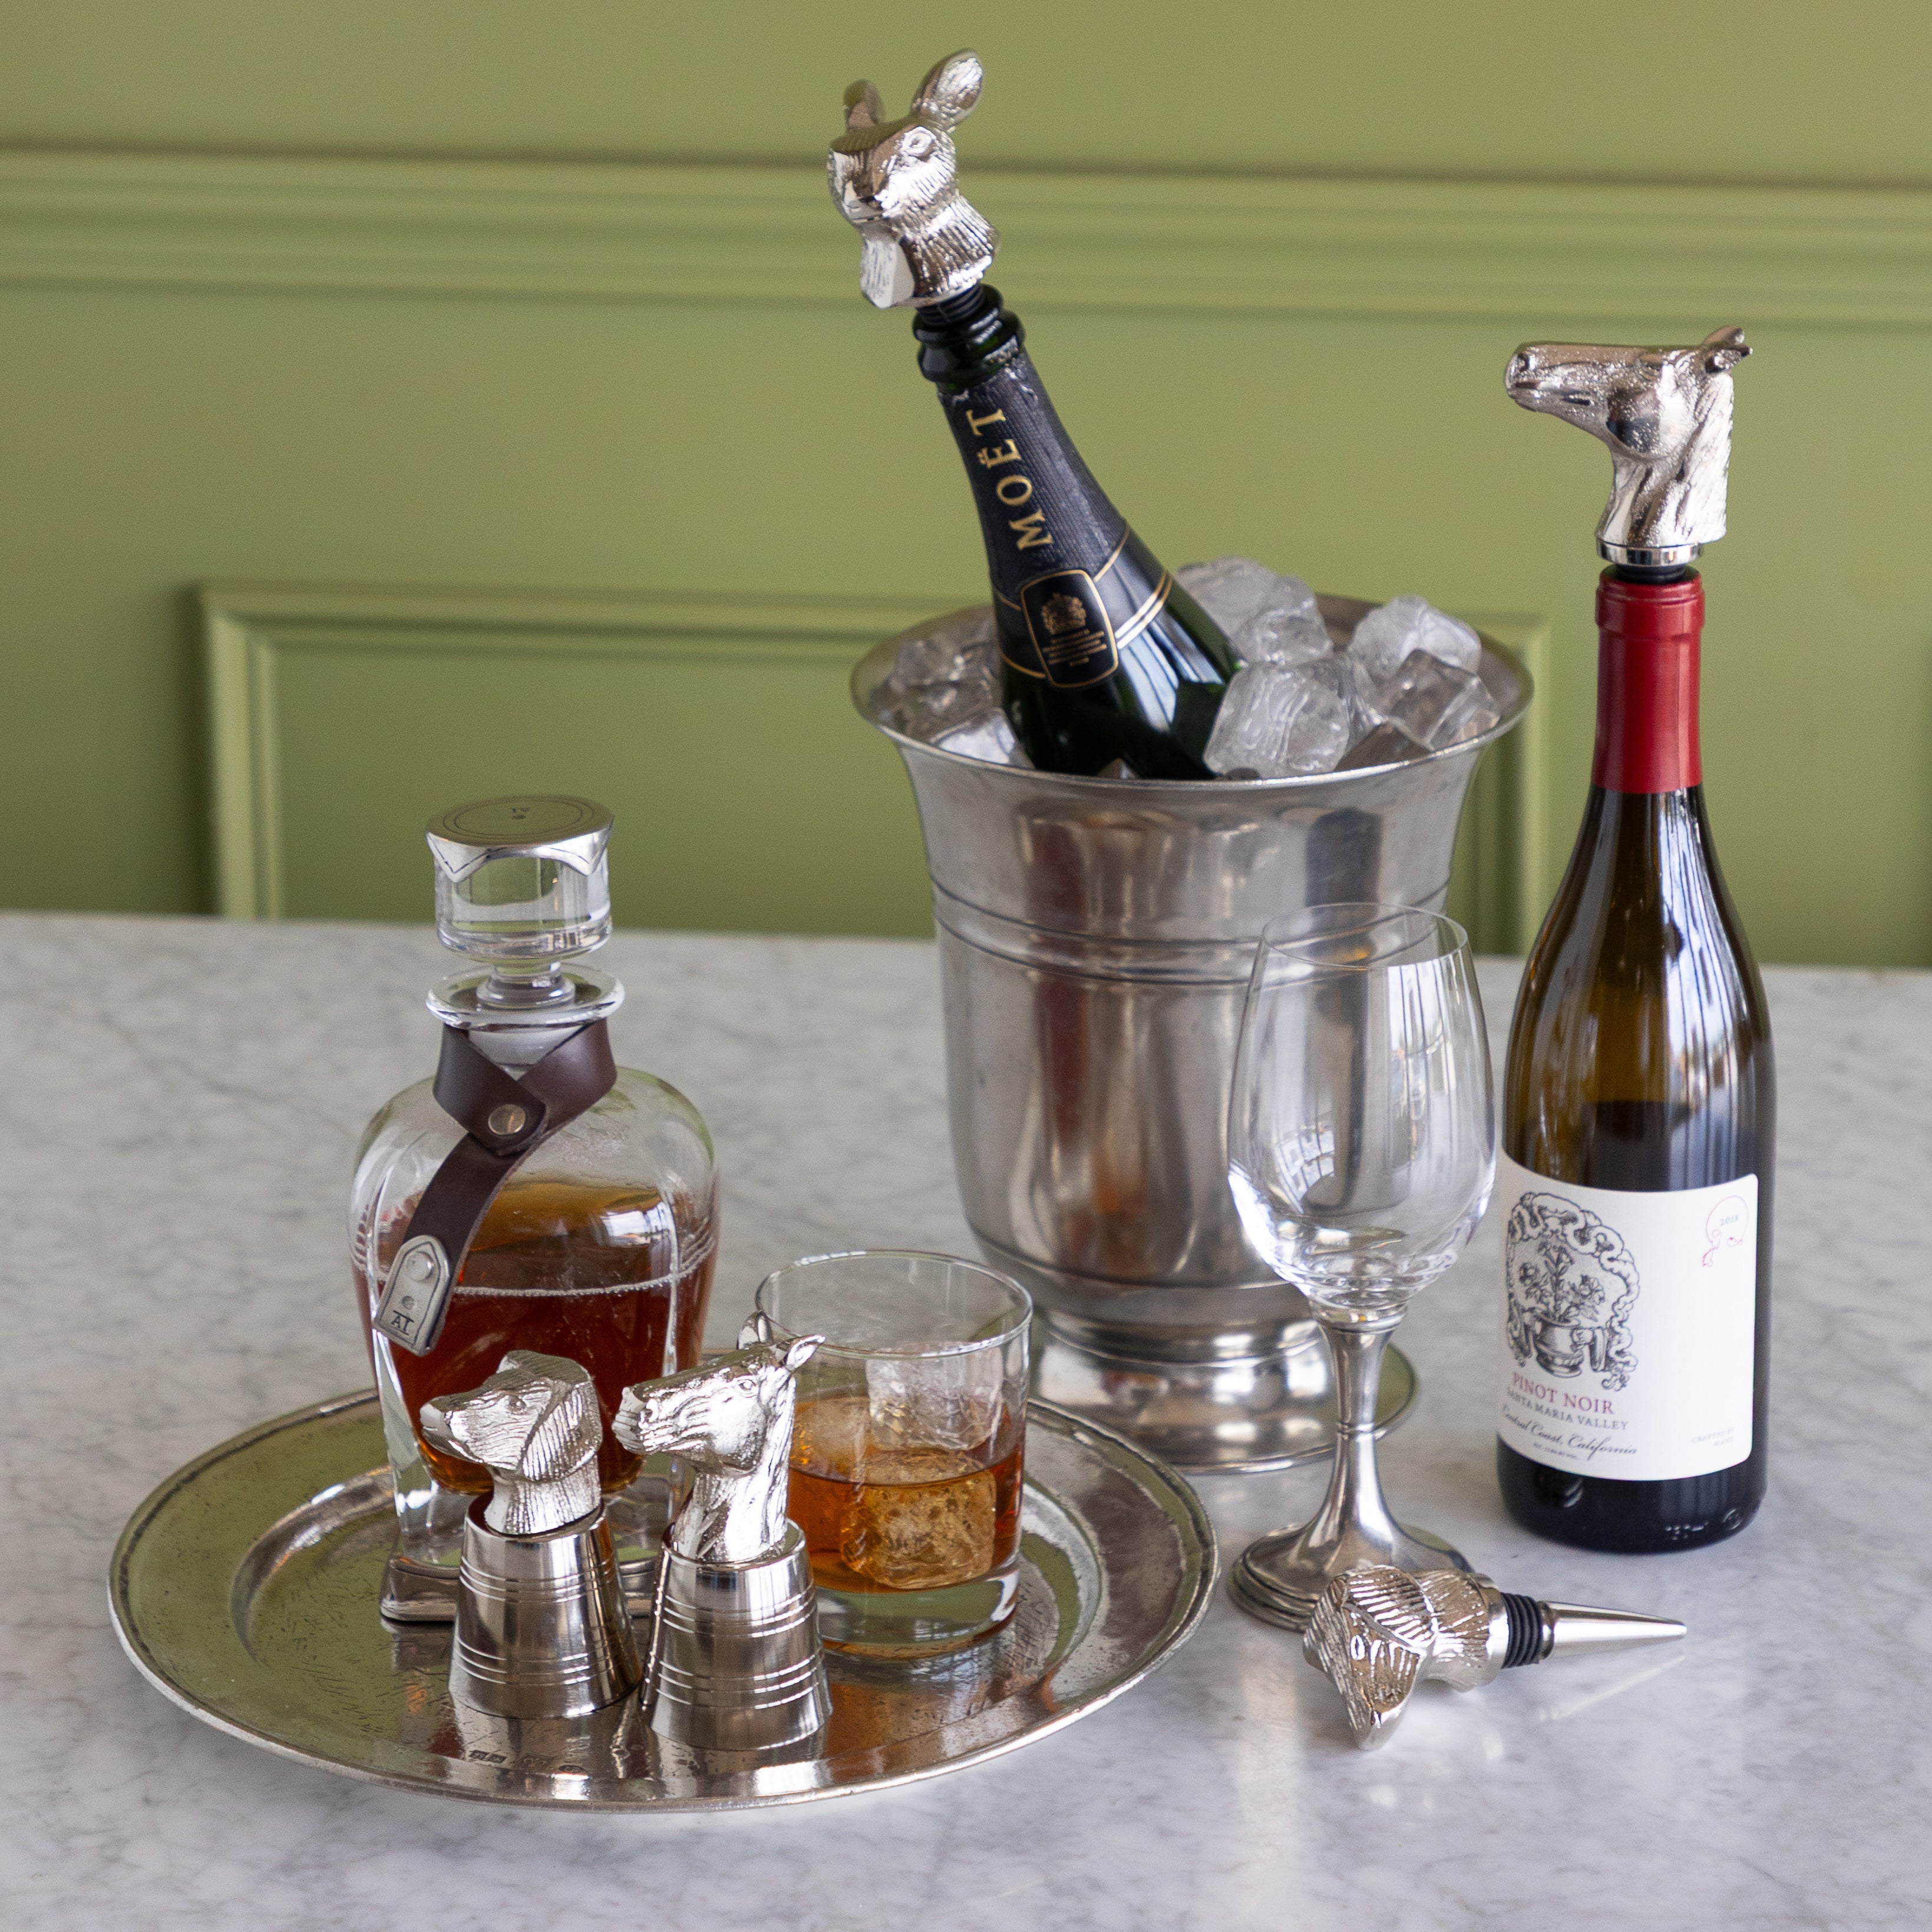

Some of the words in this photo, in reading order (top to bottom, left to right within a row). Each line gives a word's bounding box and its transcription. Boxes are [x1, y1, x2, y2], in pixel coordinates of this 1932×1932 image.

[966, 408, 1053, 550] MOËT
[1512, 1372, 1557, 1403] PINOT
[1563, 1393, 1614, 1414] NOIR
[1534, 1402, 1573, 1424] MARIA
[1576, 1415, 1629, 1431] VALLEY
[1531, 1421, 1564, 1445] Coast,
[1568, 1434, 1638, 1461] California
